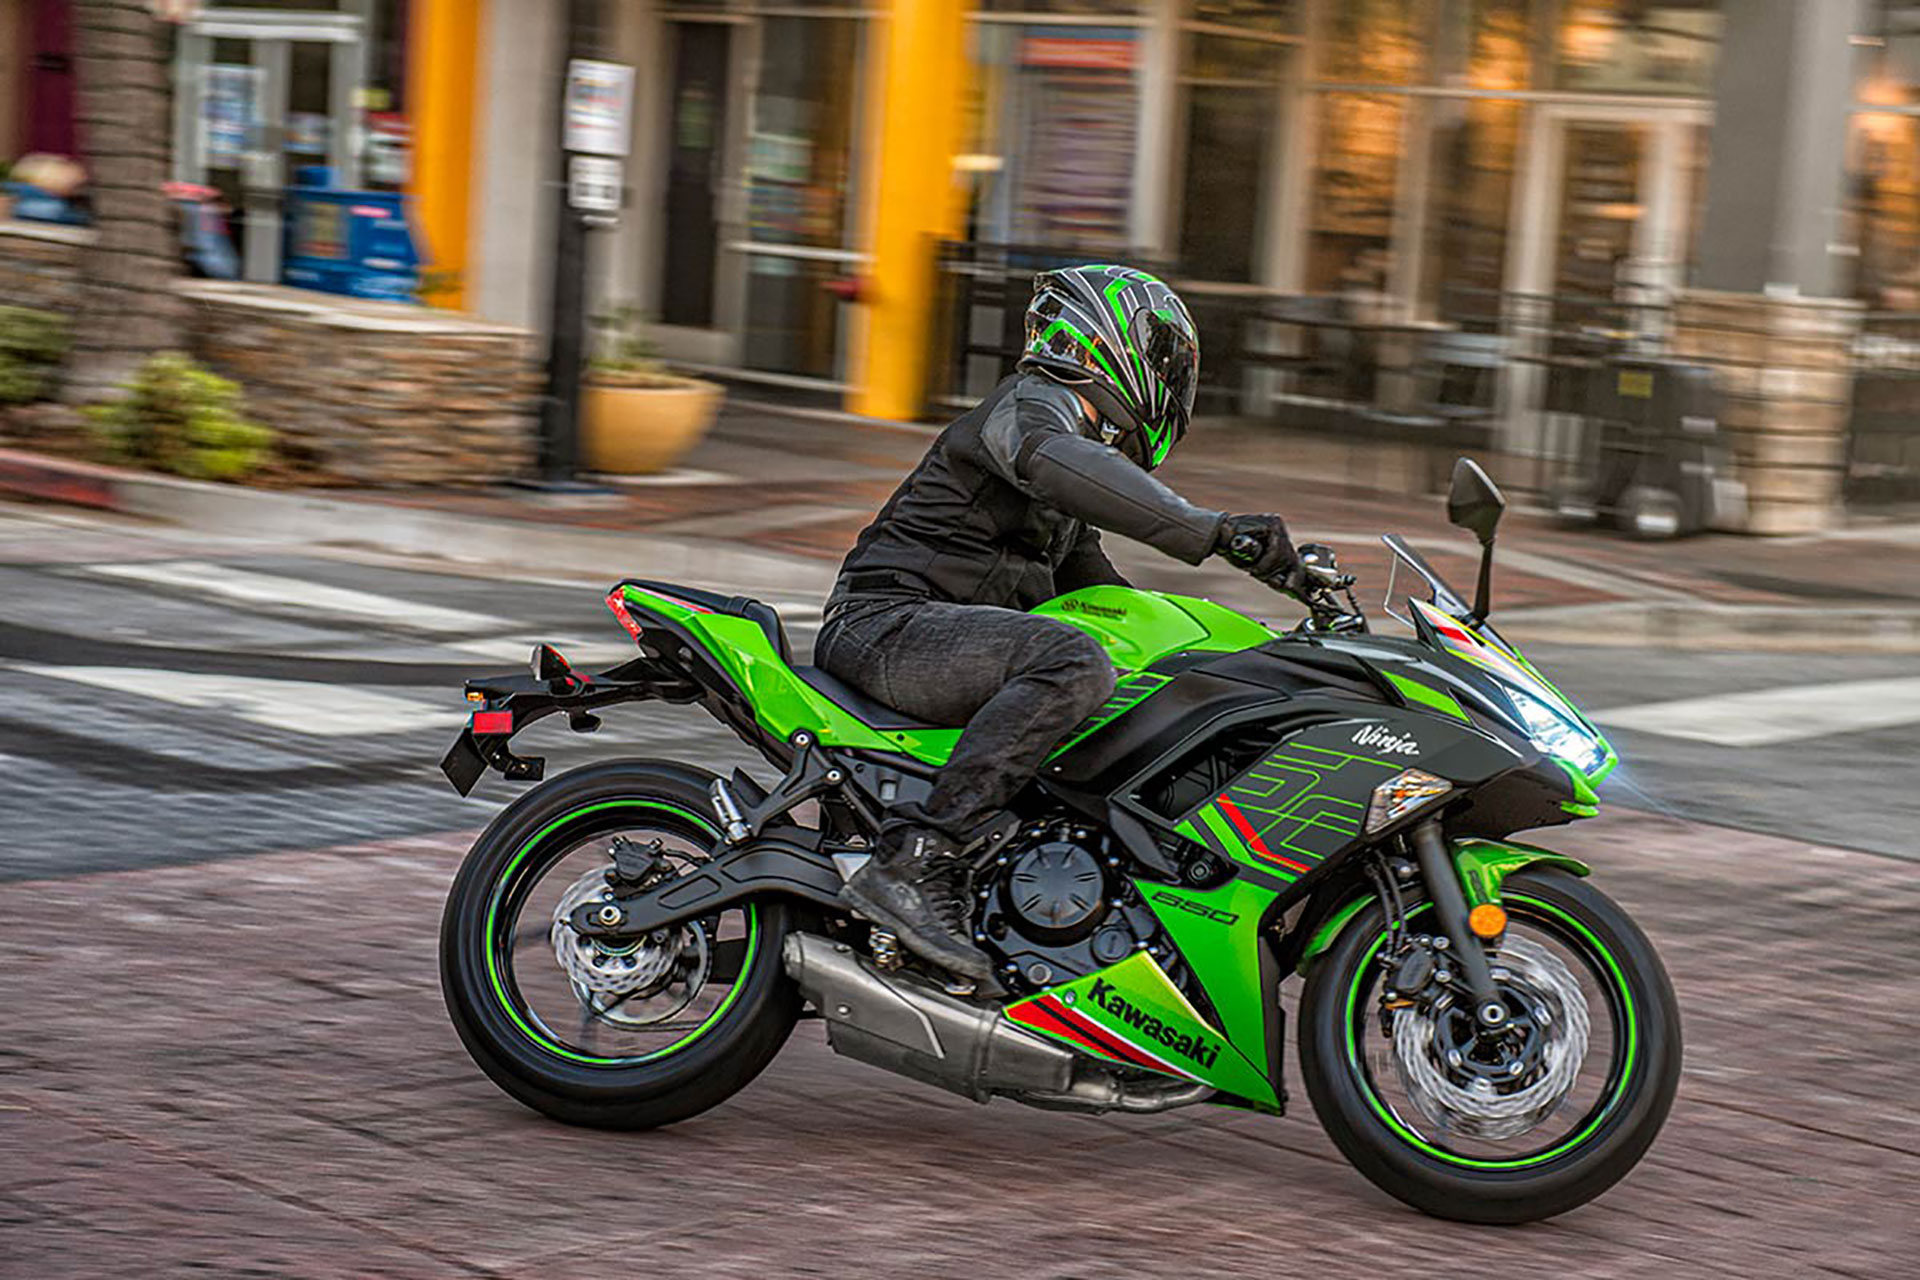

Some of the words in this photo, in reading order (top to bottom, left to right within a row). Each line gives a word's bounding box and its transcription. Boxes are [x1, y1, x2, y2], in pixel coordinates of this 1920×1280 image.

[1351, 724, 1420, 755] Ninja
[1151, 892, 1239, 926] 650
[1087, 976, 1222, 1070] Kawasaki
